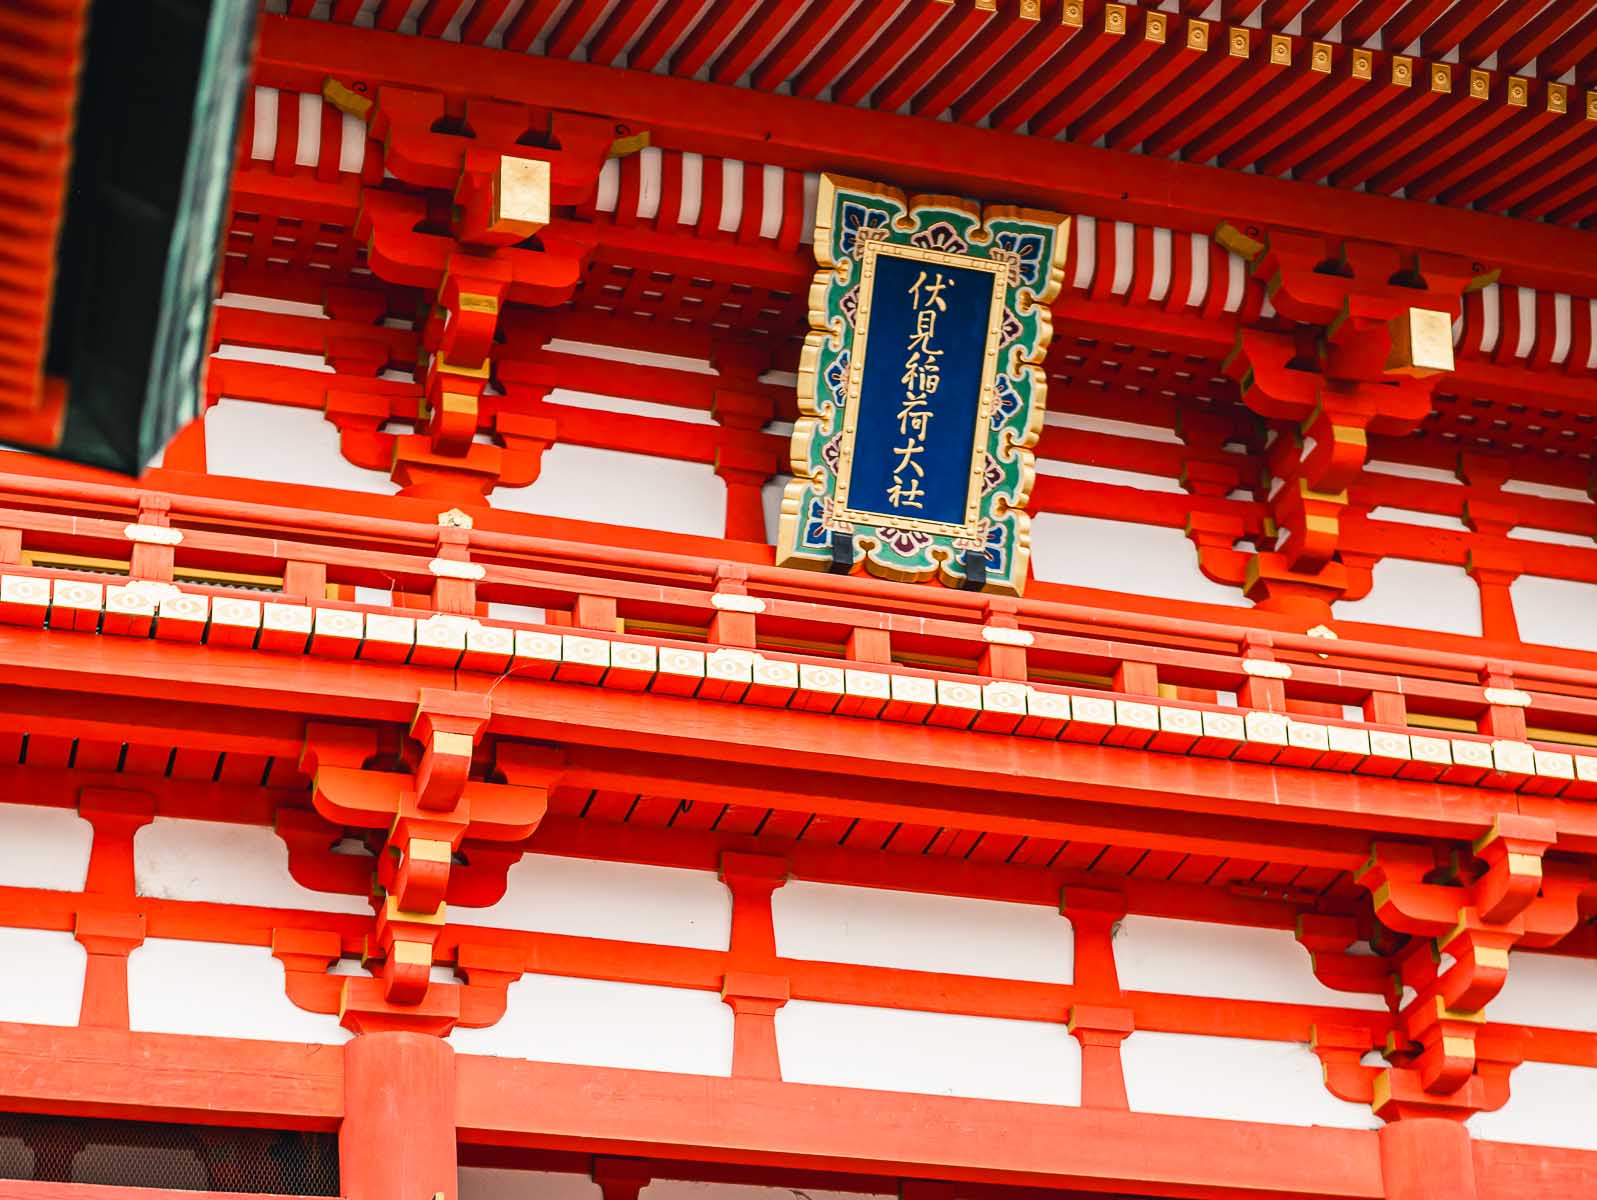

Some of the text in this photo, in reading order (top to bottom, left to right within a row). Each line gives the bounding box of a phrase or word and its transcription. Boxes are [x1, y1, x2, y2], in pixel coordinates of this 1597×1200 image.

[887, 271, 954, 509] 伏見稲荷大社
